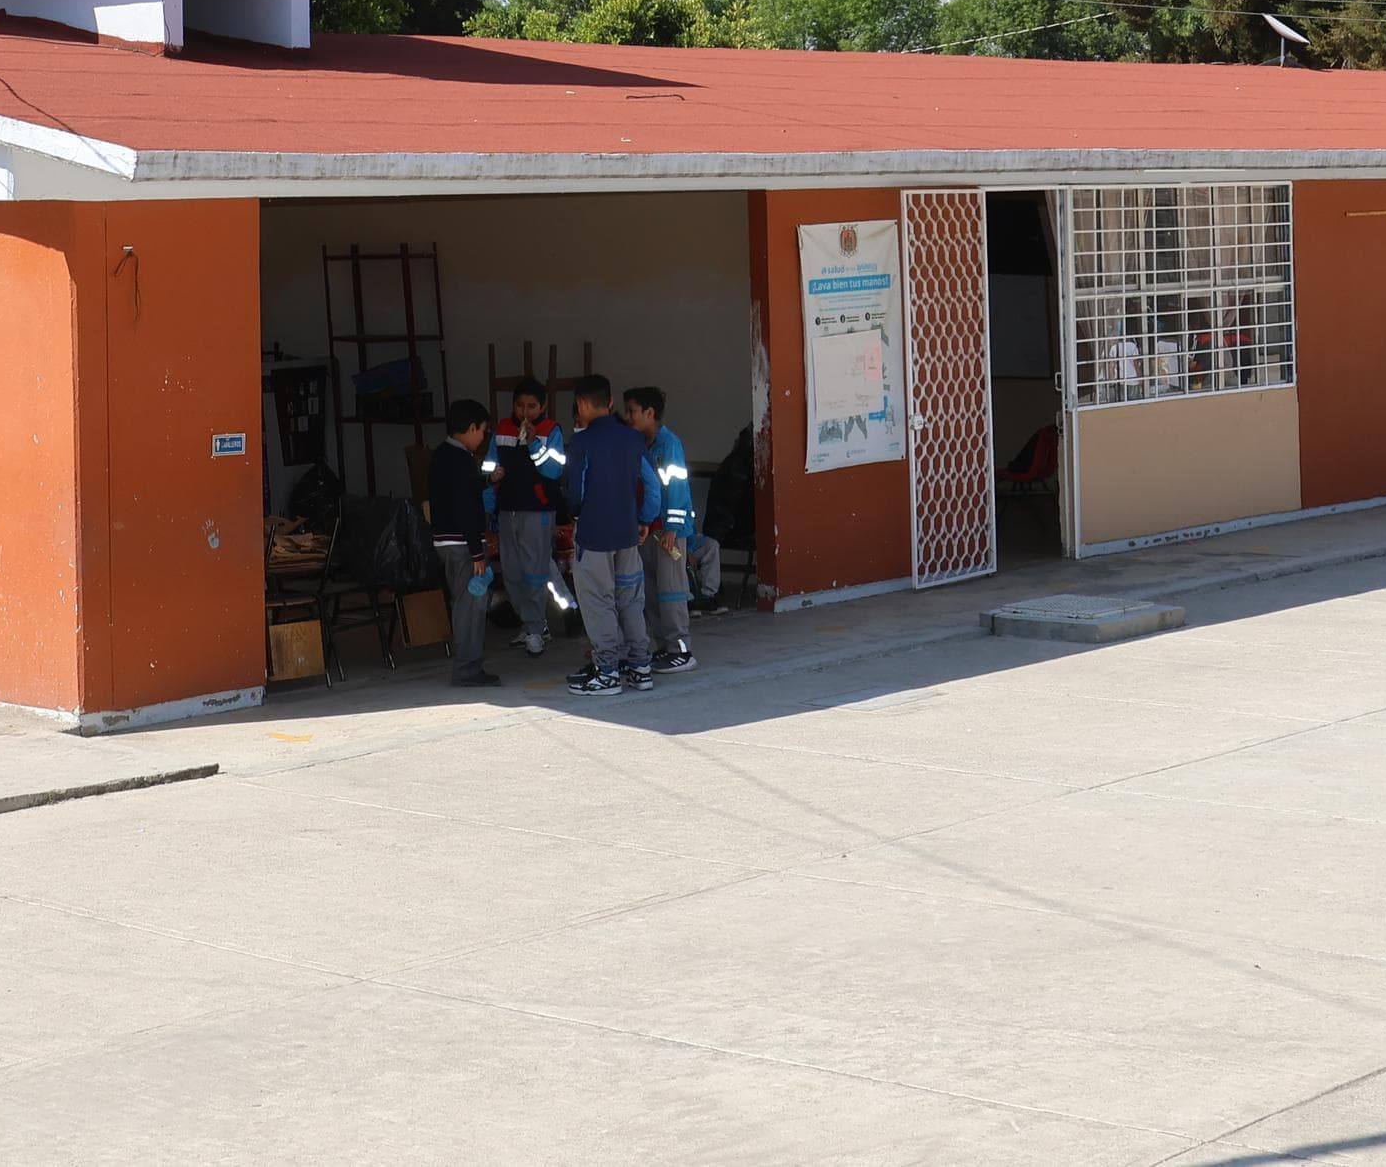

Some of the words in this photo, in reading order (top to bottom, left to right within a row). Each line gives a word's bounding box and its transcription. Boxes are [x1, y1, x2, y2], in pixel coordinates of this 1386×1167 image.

[813, 282, 832, 294] ¡Lava
[833, 278, 849, 290] bien
[849, 279, 861, 289] tus
[862, 276, 889, 288] manos!
